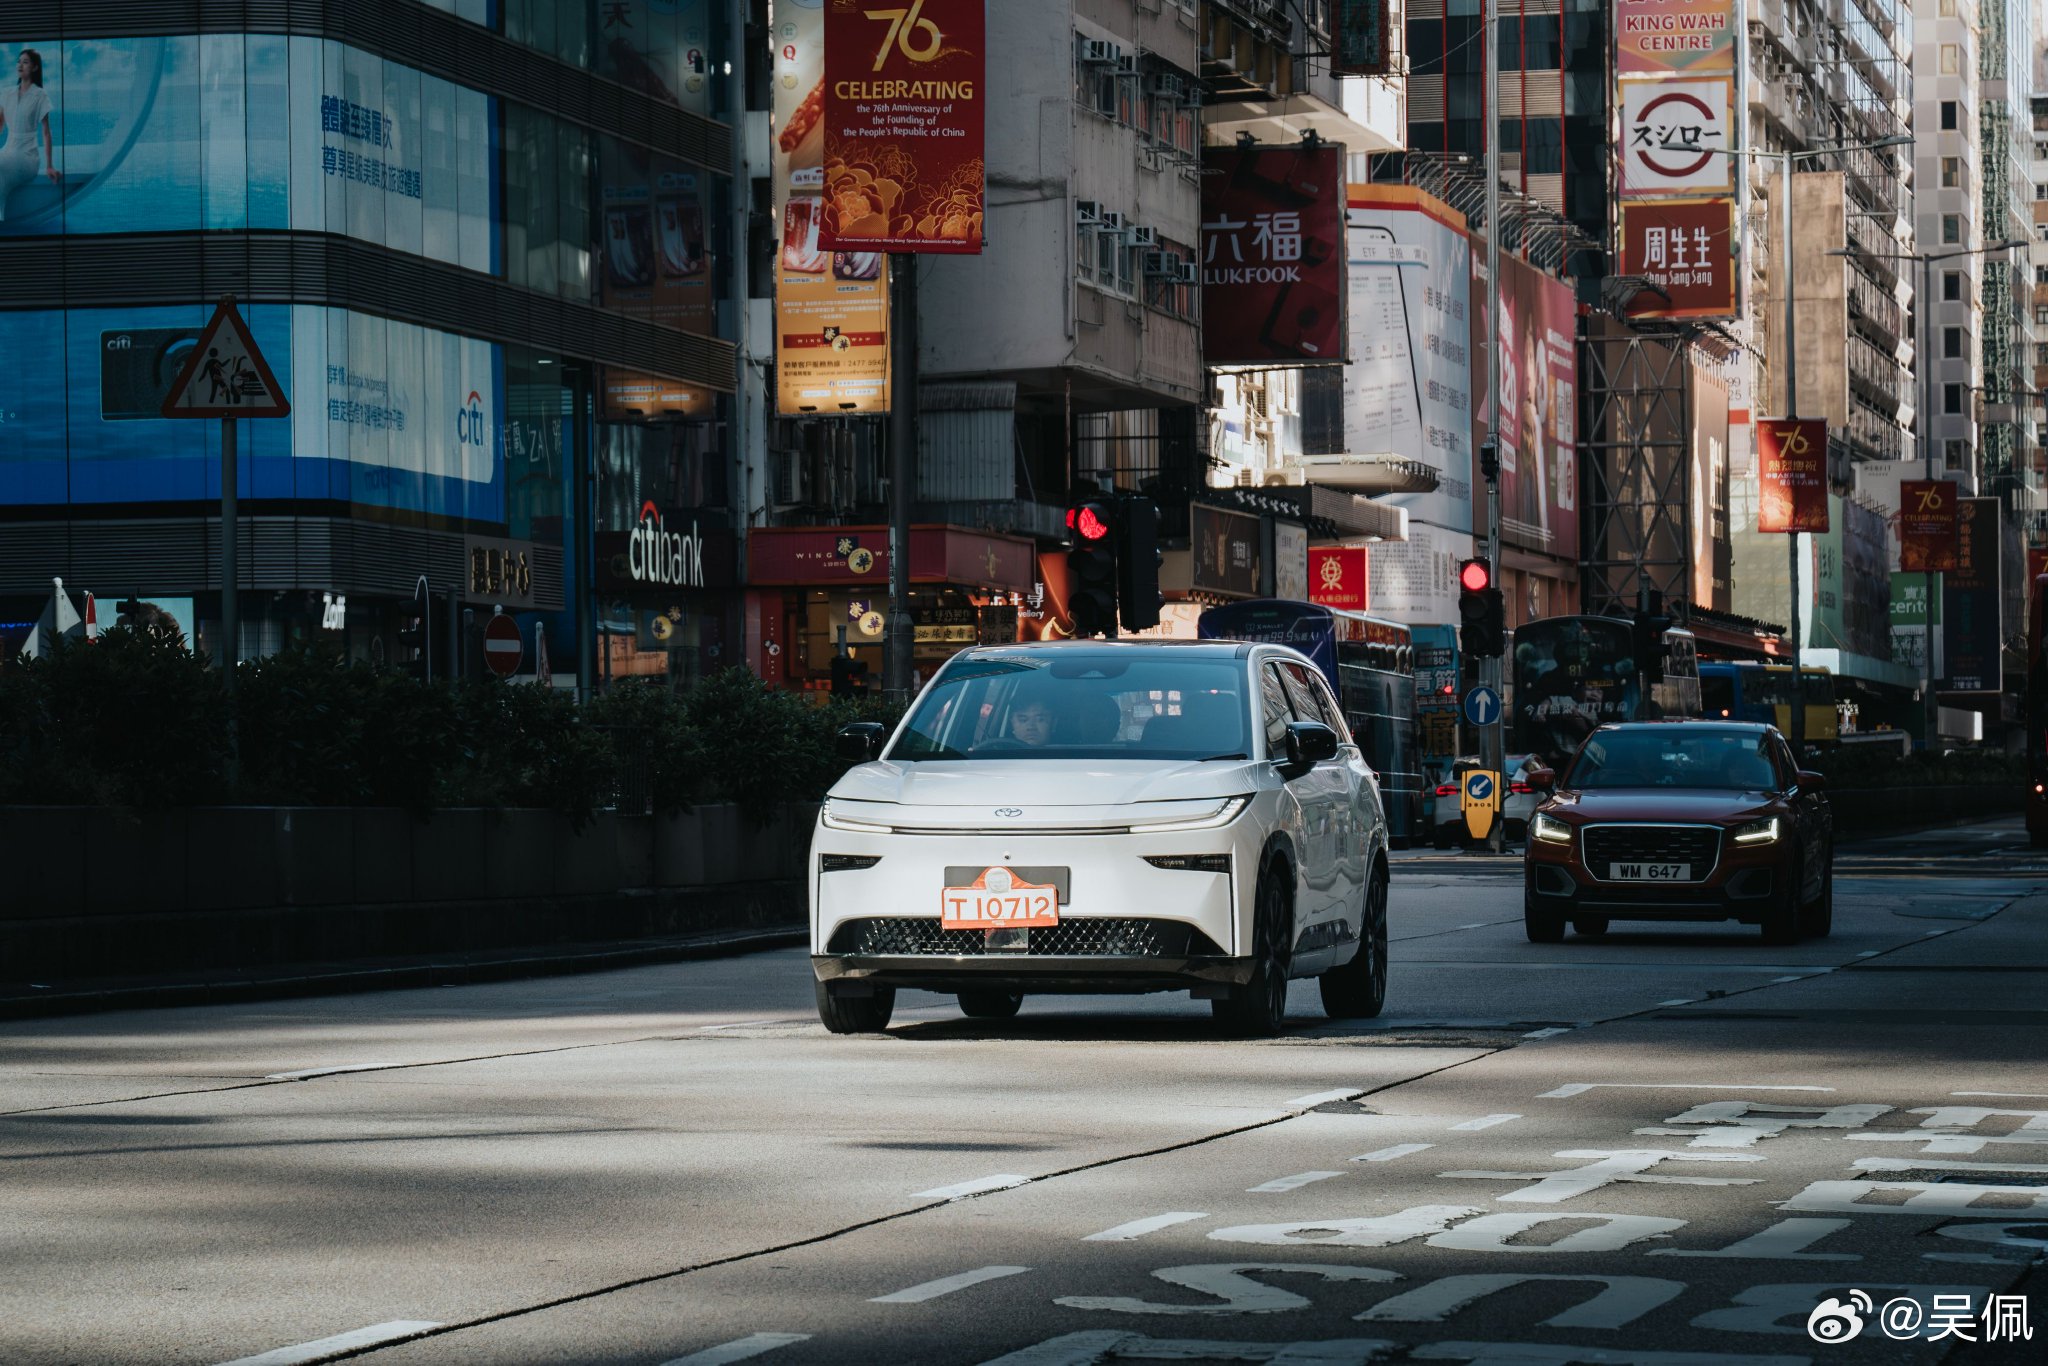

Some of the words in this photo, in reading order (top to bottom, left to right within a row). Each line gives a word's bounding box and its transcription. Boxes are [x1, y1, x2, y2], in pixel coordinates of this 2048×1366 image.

[1626, 15, 1675, 32] KING
[1680, 13, 1726, 30] WAH
[864, 0, 941, 72] 76
[1638, 34, 1713, 51] CENTRE
[834, 80, 974, 100] CELEBRATING
[856, 104, 871, 113] the
[873, 104, 890, 113] 76th
[892, 103, 941, 116] Anniversary
[943, 104, 953, 113] of
[872, 116, 885, 125] the
[887, 116, 925, 127] Founding
[927, 116, 937, 125] of
[843, 128, 857, 137] the
[859, 128, 891, 139] People's
[893, 128, 929, 139] Republic
[931, 128, 940, 137] of
[941, 128, 966, 137] China
[1631, 123, 1722, 147] スシロー
[1202, 211, 1302, 264] 六福
[1643, 225, 1713, 270] 周生生
[1362, 247, 1377, 257] ETF
[1203, 265, 1302, 285] LUKFOOK
[1668, 269, 1691, 287] Sang
[1691, 269, 1713, 287] Sang
[106, 334, 131, 351] citi
[456, 397, 484, 447] citi
[1776, 425, 1809, 458] 76
[1915, 485, 1942, 512] 76
[629, 510, 705, 588] citibank
[795, 551, 833, 560] WING
[322, 592, 346, 630] Zoff
[1415, 669, 1457, 692] 青筋
[1620, 864, 1641, 878] WM
[1648, 865, 1682, 879] 647
